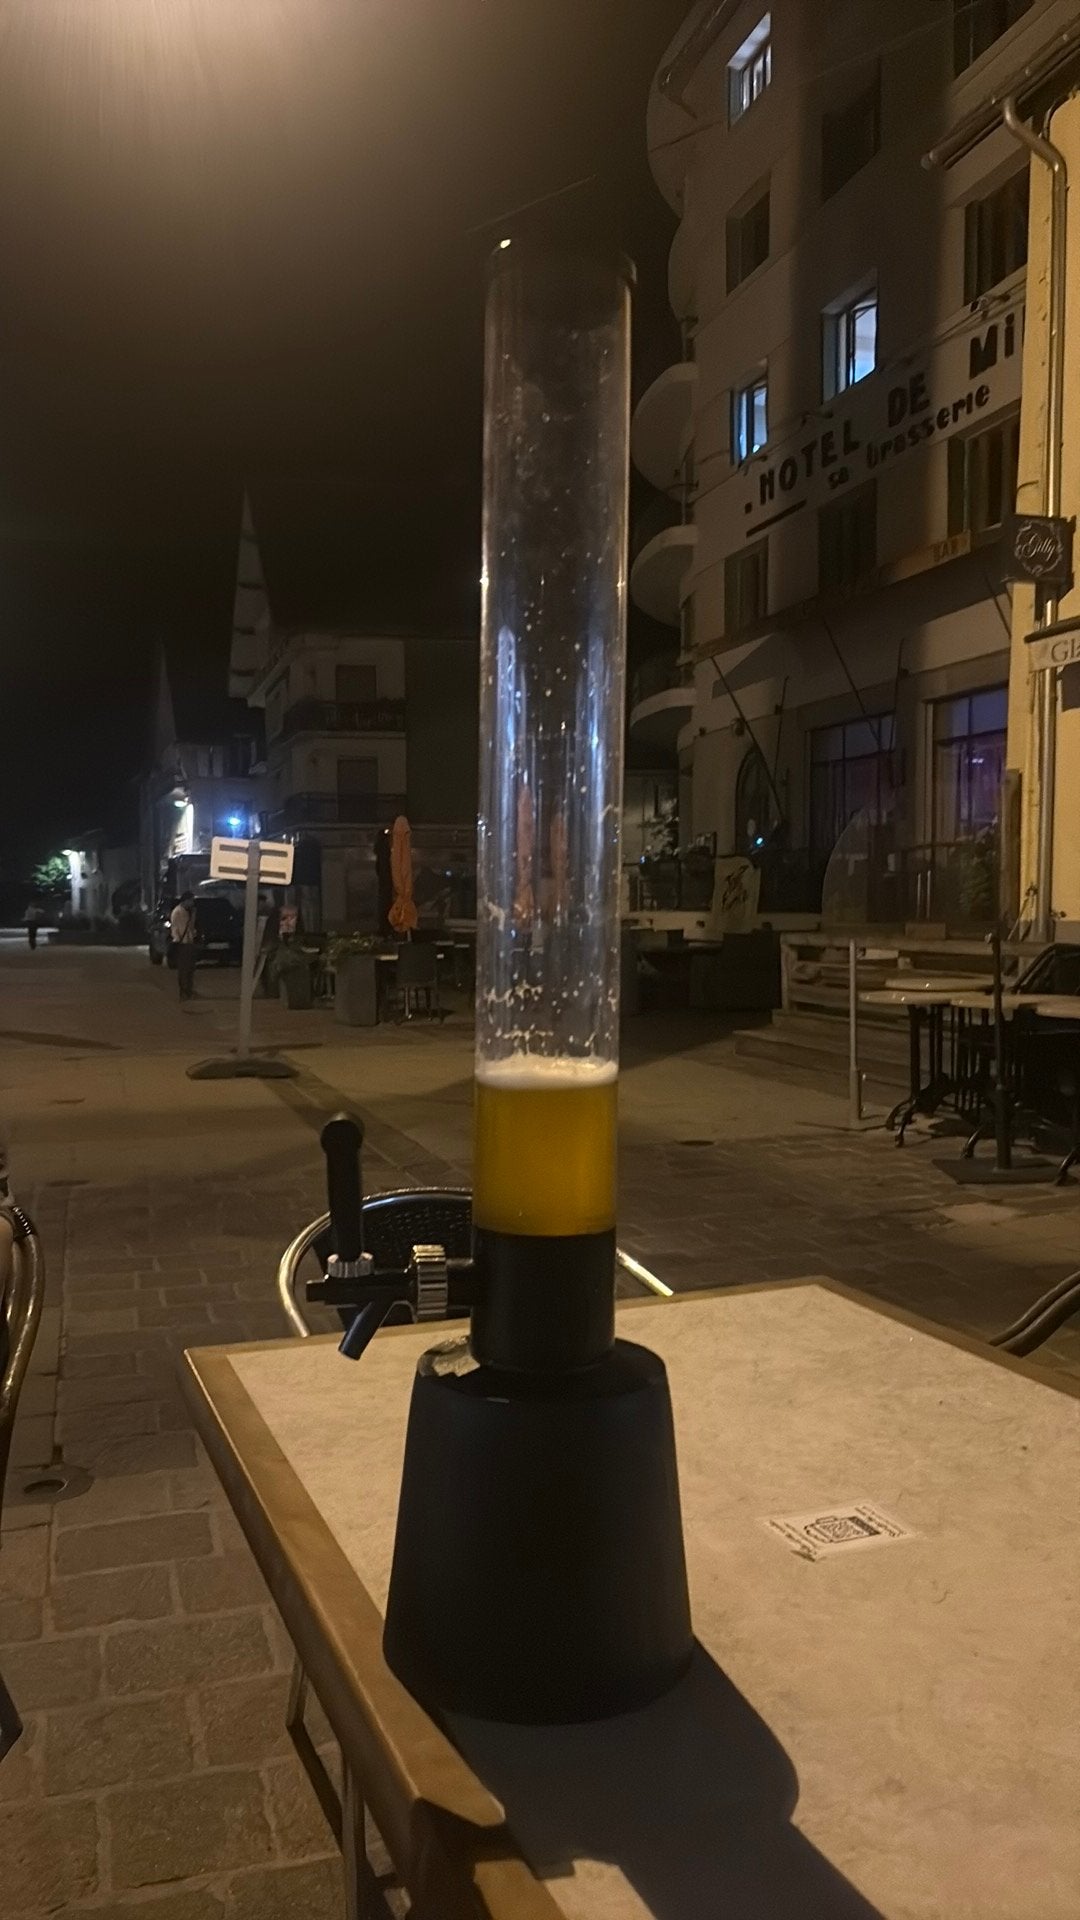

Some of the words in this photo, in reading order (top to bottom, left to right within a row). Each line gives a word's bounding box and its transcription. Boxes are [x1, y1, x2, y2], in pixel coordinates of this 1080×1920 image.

[760, 419, 860, 506] HOTEL
[888, 372, 930, 428] DE
[969, 304, 1026, 380] Mi
[828, 466, 850, 490] sa
[866, 384, 990, 470] brasserie
[1021, 533, 1056, 562] Gilly
